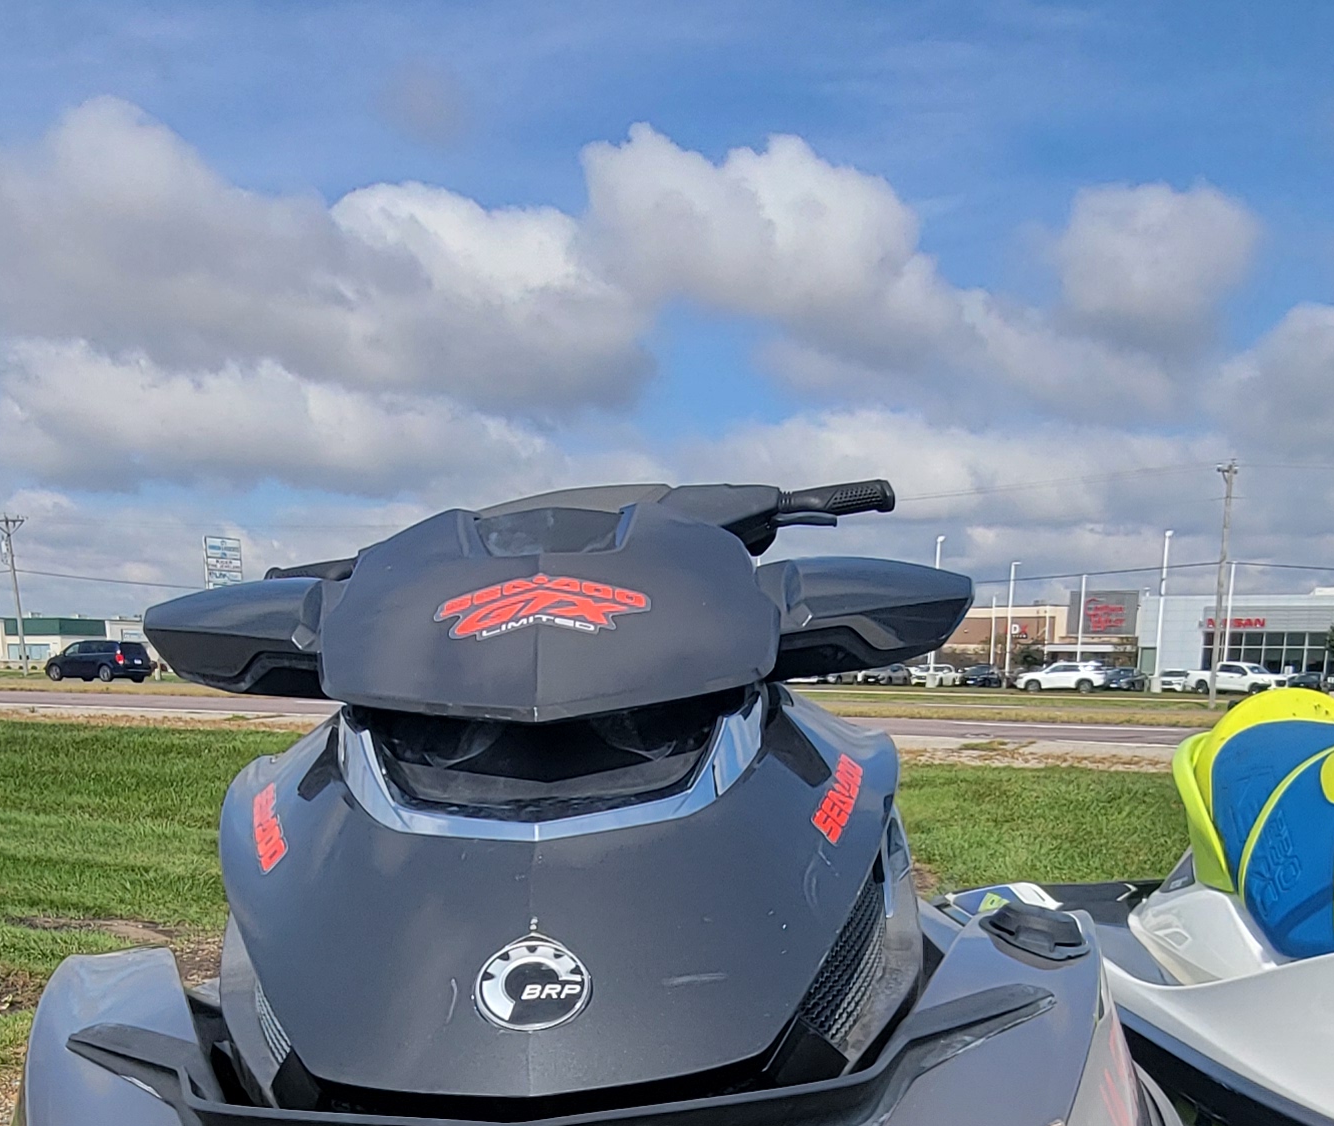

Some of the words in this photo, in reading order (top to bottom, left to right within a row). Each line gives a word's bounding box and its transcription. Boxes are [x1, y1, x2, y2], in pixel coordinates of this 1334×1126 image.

[455, 590, 628, 635] GTX
[1207, 617, 1266, 628] NSAN
[481, 614, 595, 638] LIMITED
[521, 984, 581, 1000] BRP
